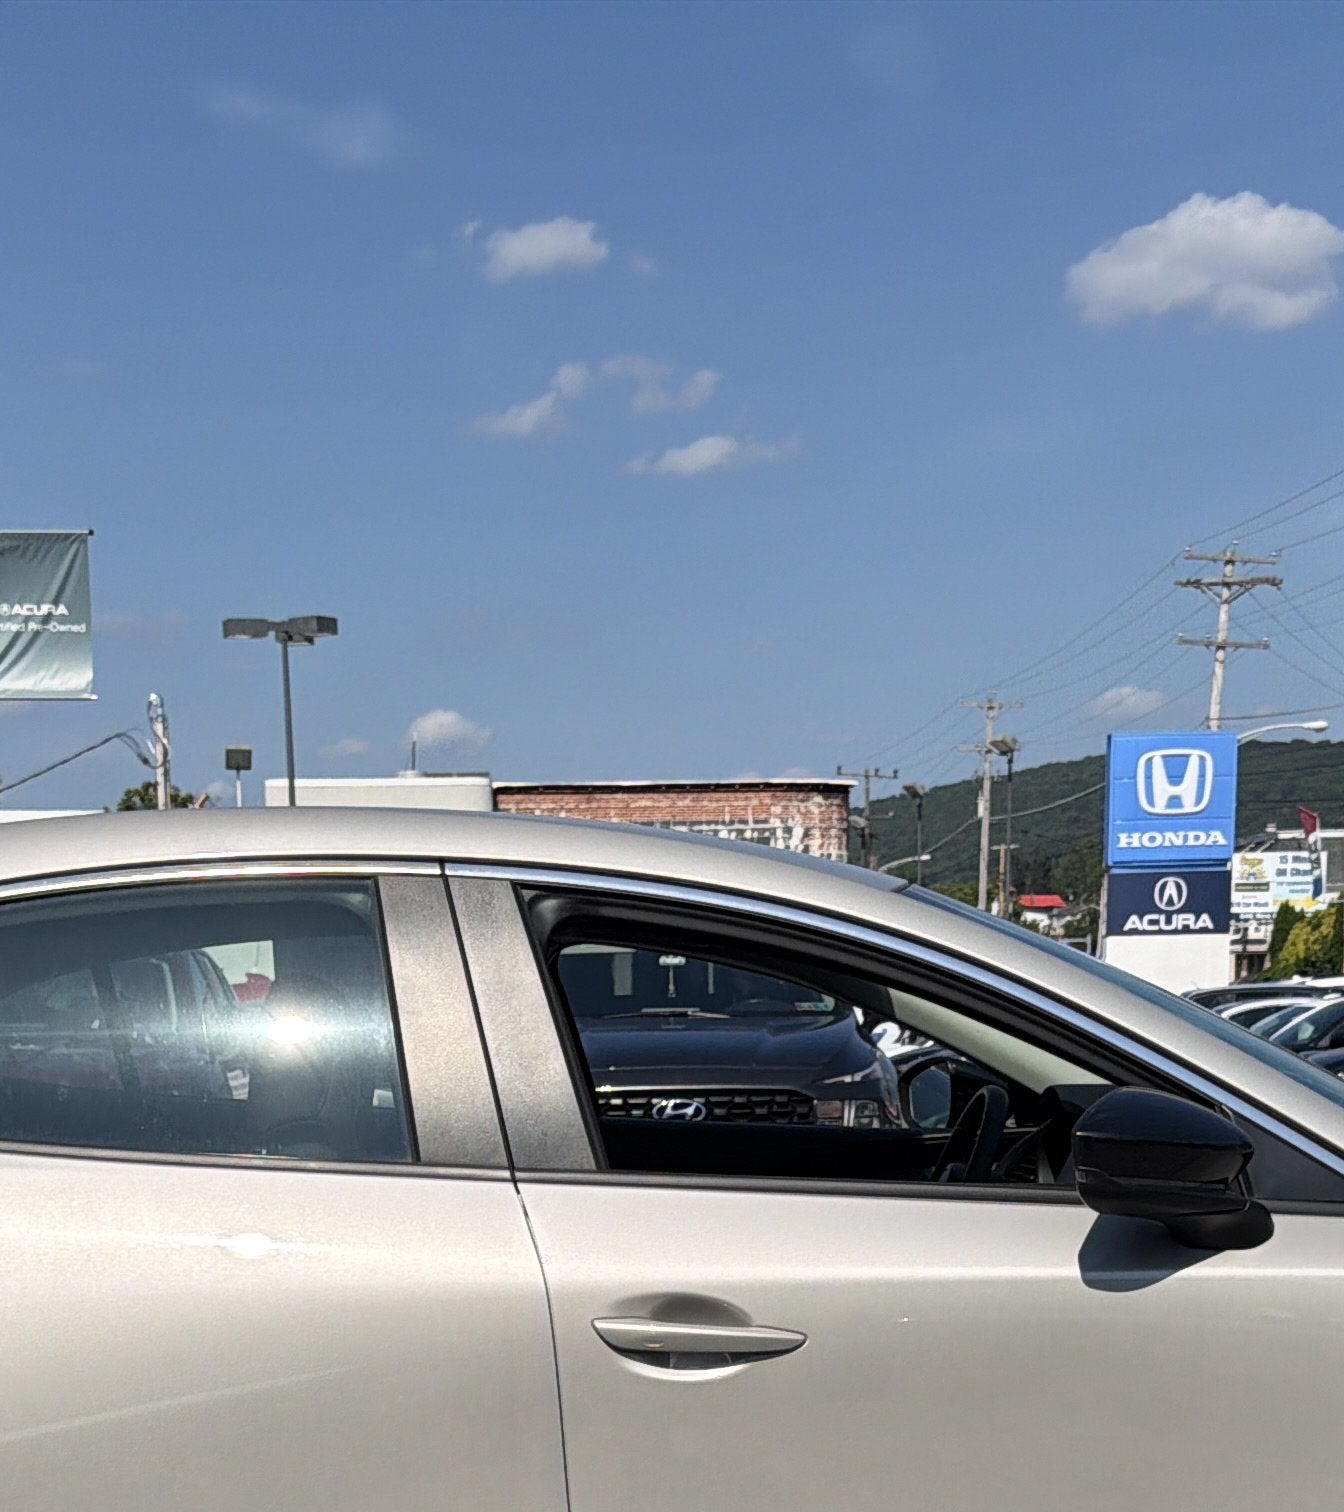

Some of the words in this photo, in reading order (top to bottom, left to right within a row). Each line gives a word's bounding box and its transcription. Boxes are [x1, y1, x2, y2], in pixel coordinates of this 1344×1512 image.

[11, 602, 70, 616] ACURA
[27, 621, 86, 633] Pre-Owned
[1116, 830, 1229, 848] HONDA
[1123, 913, 1214, 932] ACURA
